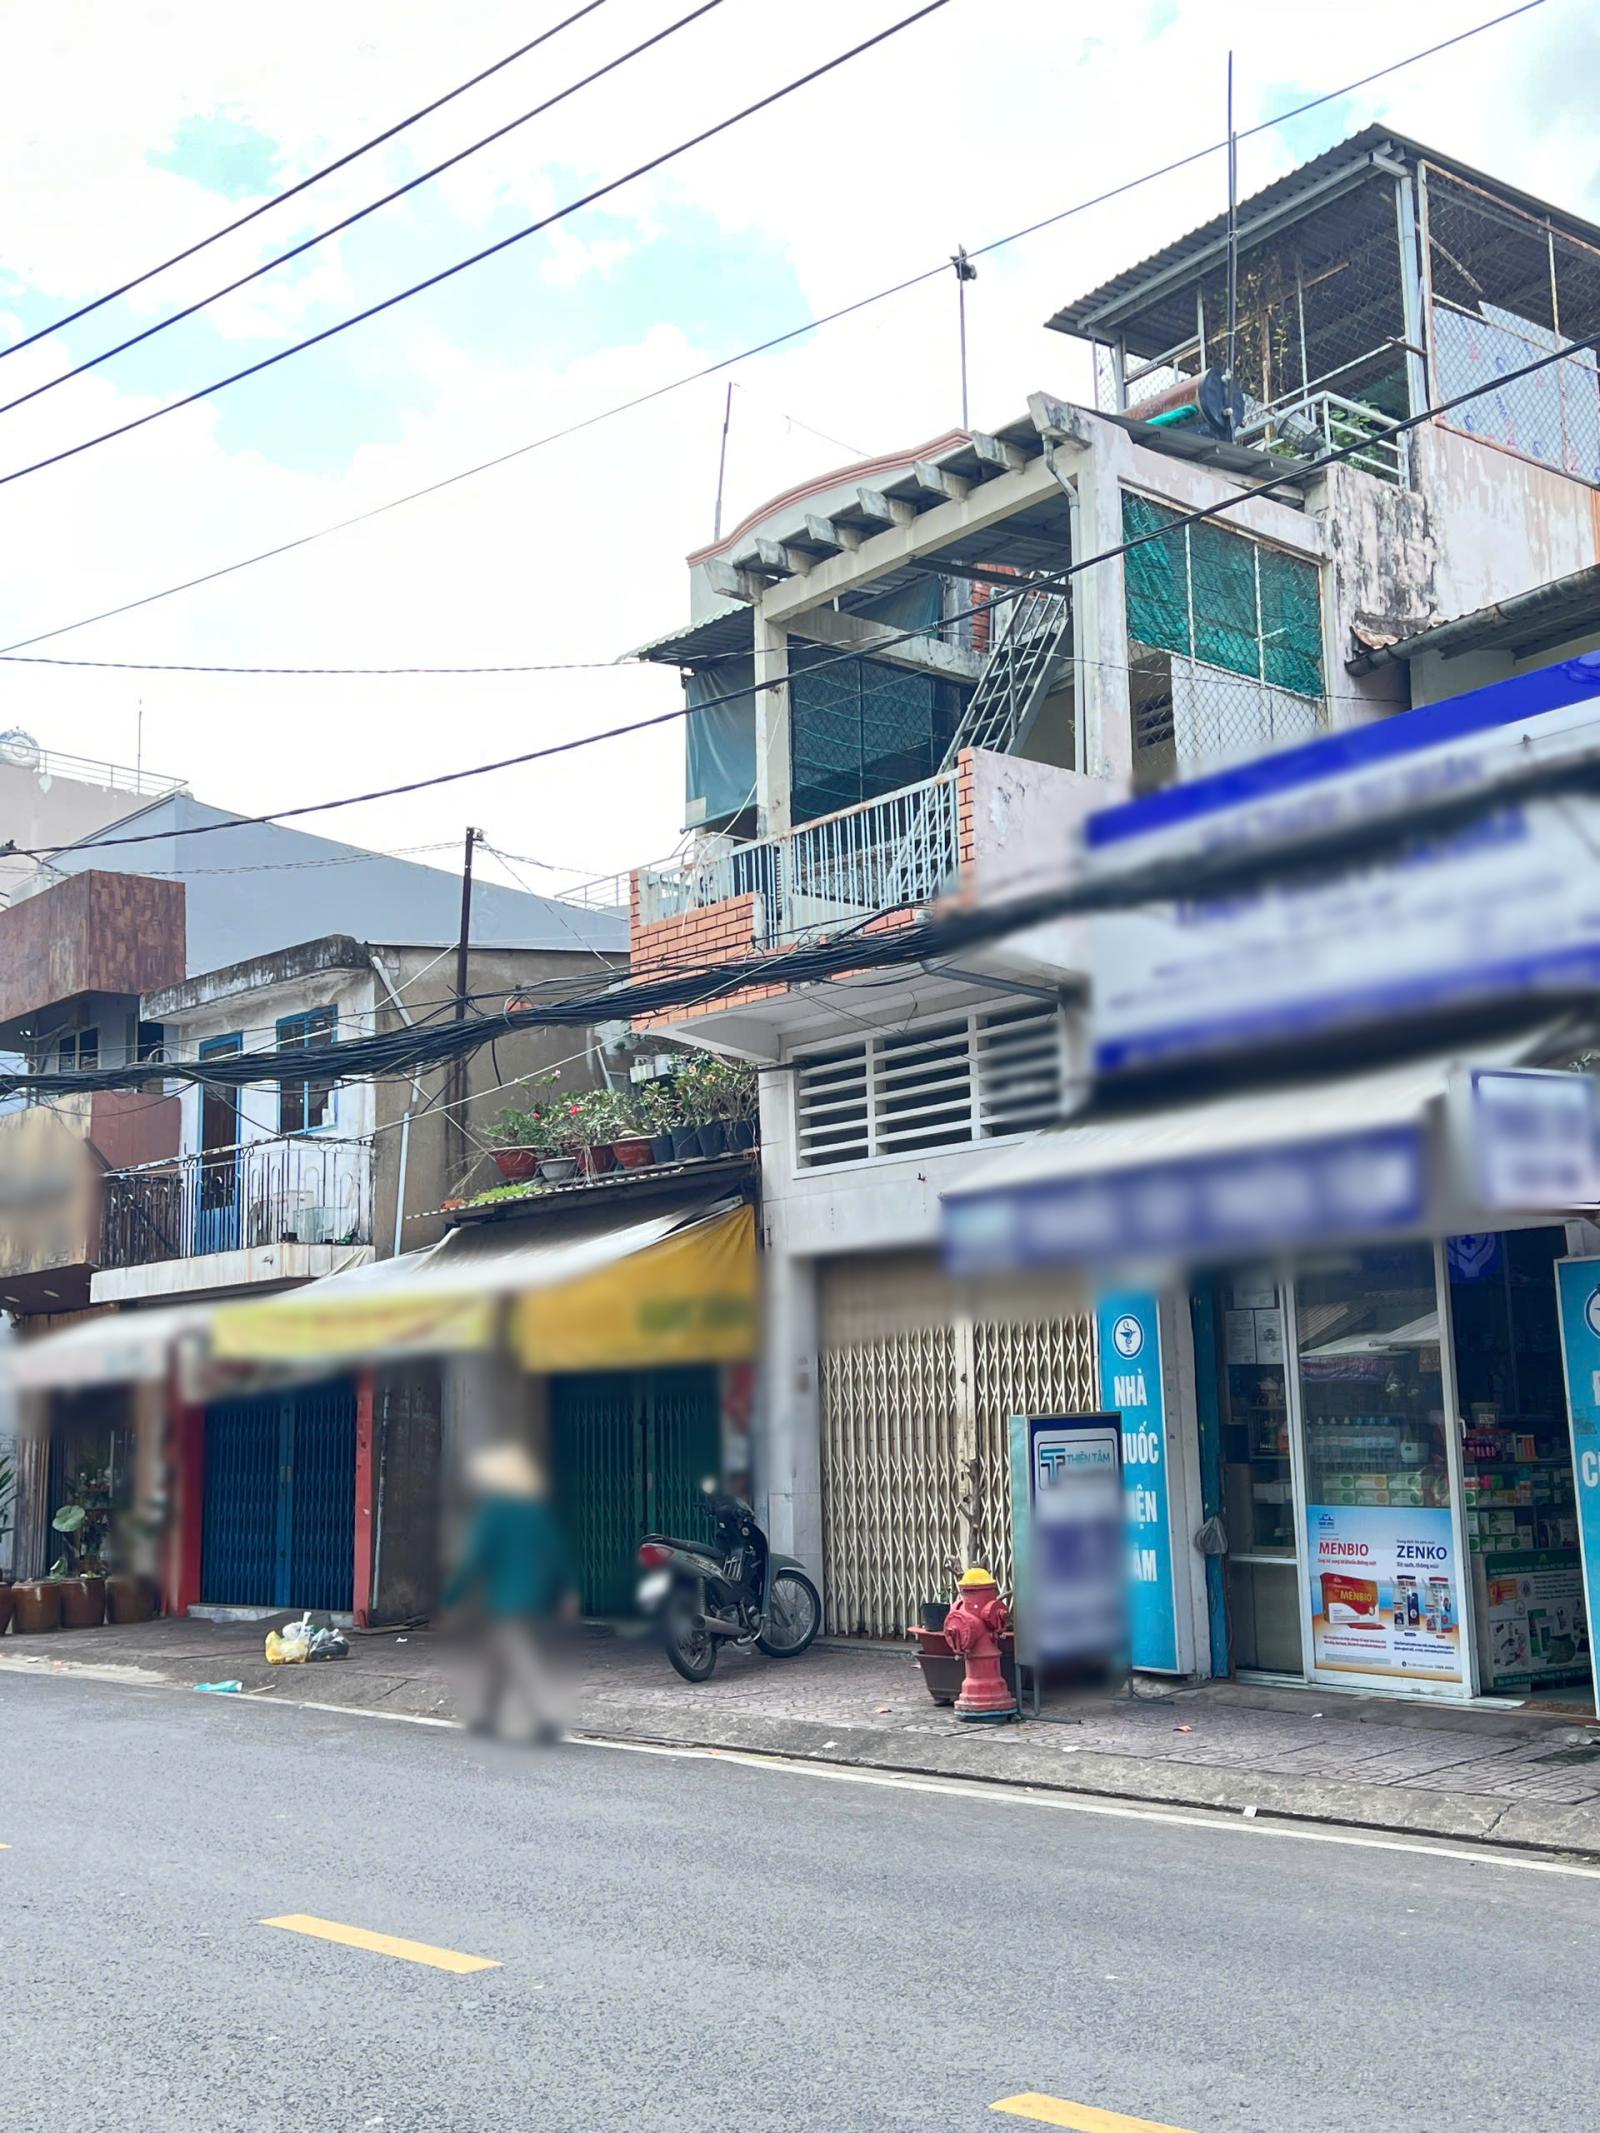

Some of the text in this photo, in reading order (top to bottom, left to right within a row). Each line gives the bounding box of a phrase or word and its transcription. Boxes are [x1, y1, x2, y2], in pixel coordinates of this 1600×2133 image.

[1113, 1368, 1148, 1407] NHÀ
[1318, 1541, 1370, 1557] MENBIO
[1396, 1544, 1448, 1561] ZENKO
